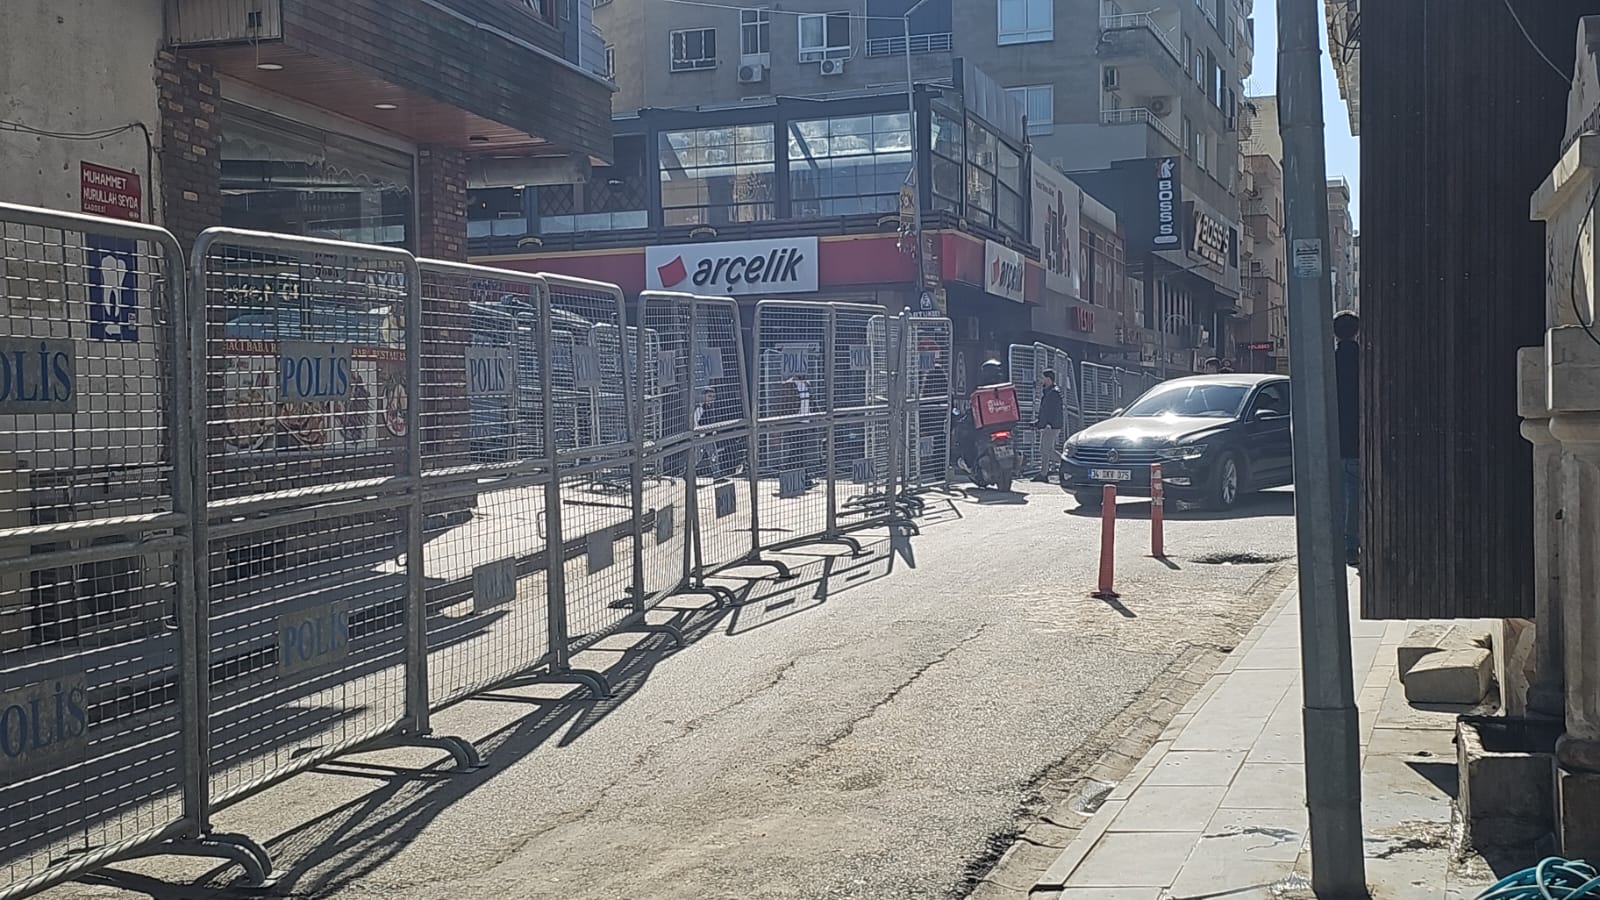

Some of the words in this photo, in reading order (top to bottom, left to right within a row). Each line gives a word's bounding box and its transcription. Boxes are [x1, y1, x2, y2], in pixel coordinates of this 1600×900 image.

[83, 168, 127, 190] MUHAMMET
[83, 187, 117, 205] NURULLAH
[692, 248, 804, 293] arçelik
[281, 345, 348, 398] POLİS
[469, 350, 505, 393] POLİS
[783, 350, 807, 373] POLİS
[283, 606, 348, 667] POLİS
